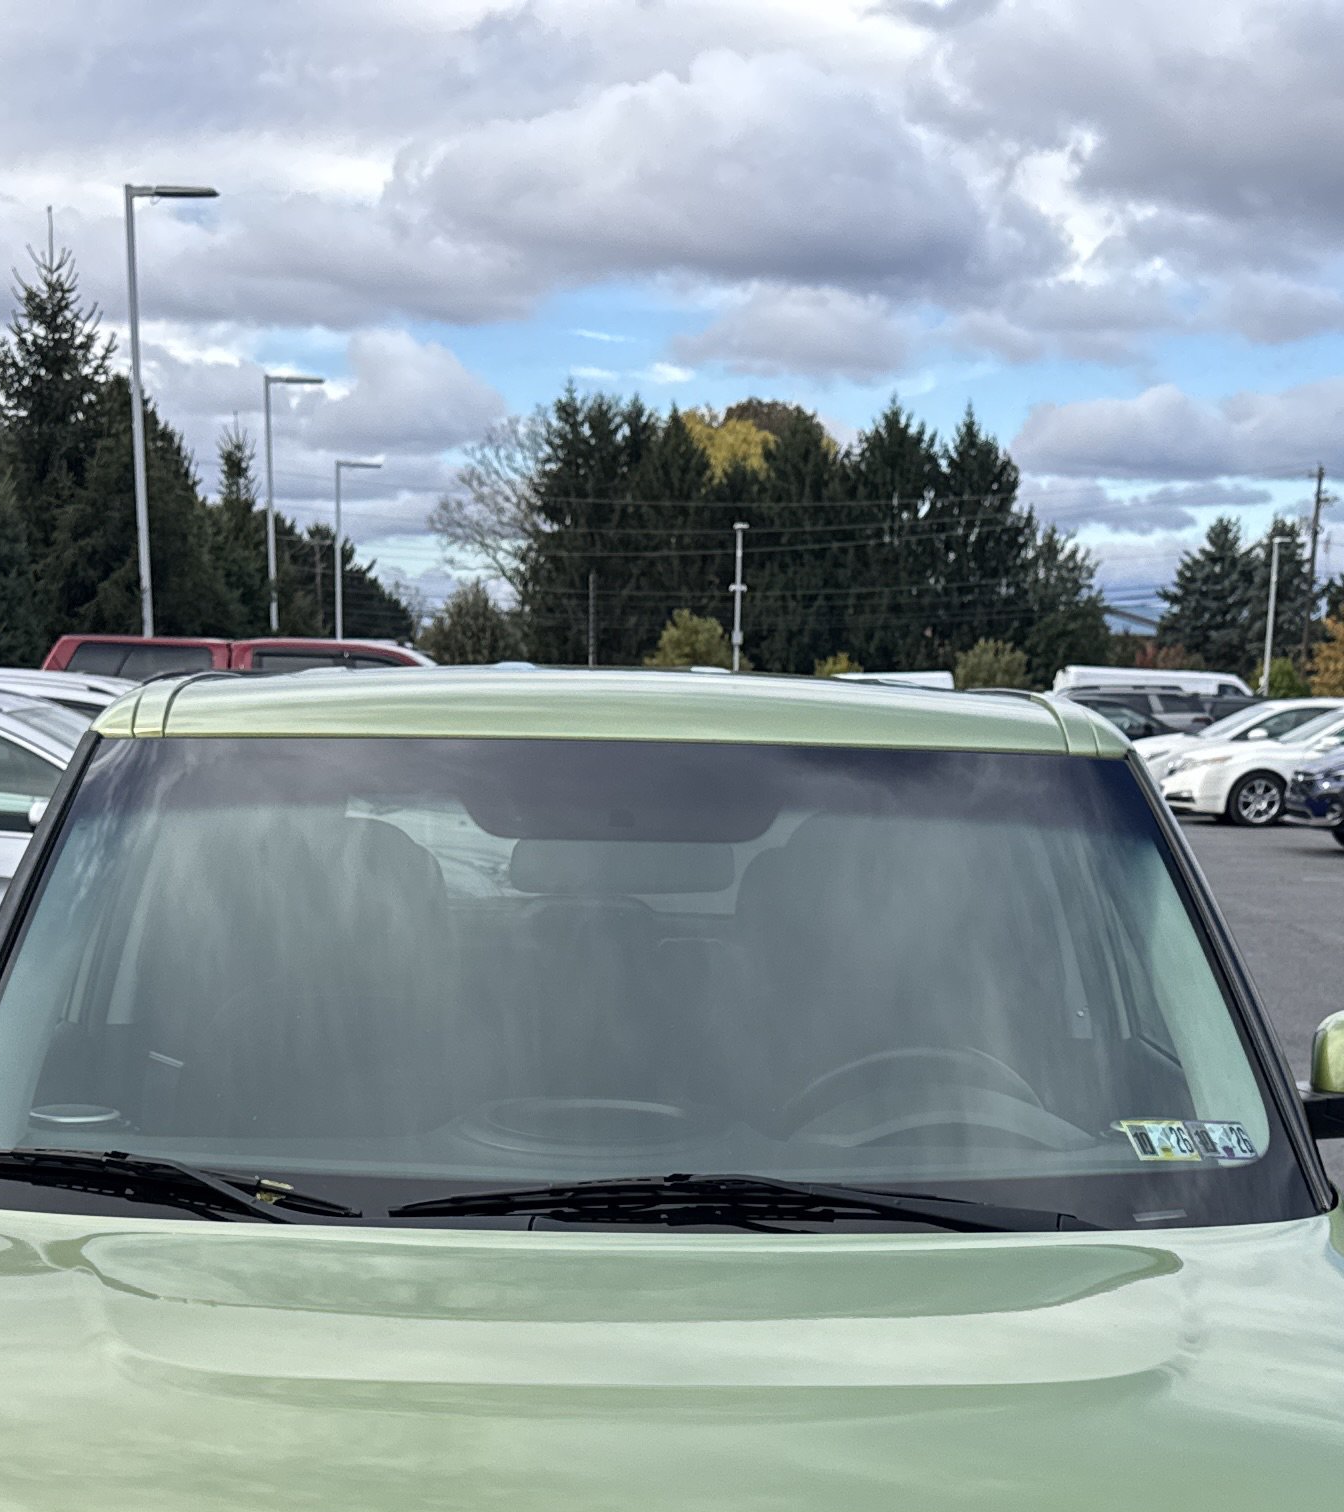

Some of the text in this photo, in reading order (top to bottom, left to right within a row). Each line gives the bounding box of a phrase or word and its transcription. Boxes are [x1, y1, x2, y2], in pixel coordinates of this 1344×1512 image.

[1134, 1126, 1195, 1155] 10 26
[1229, 1126, 1255, 1153] 26
